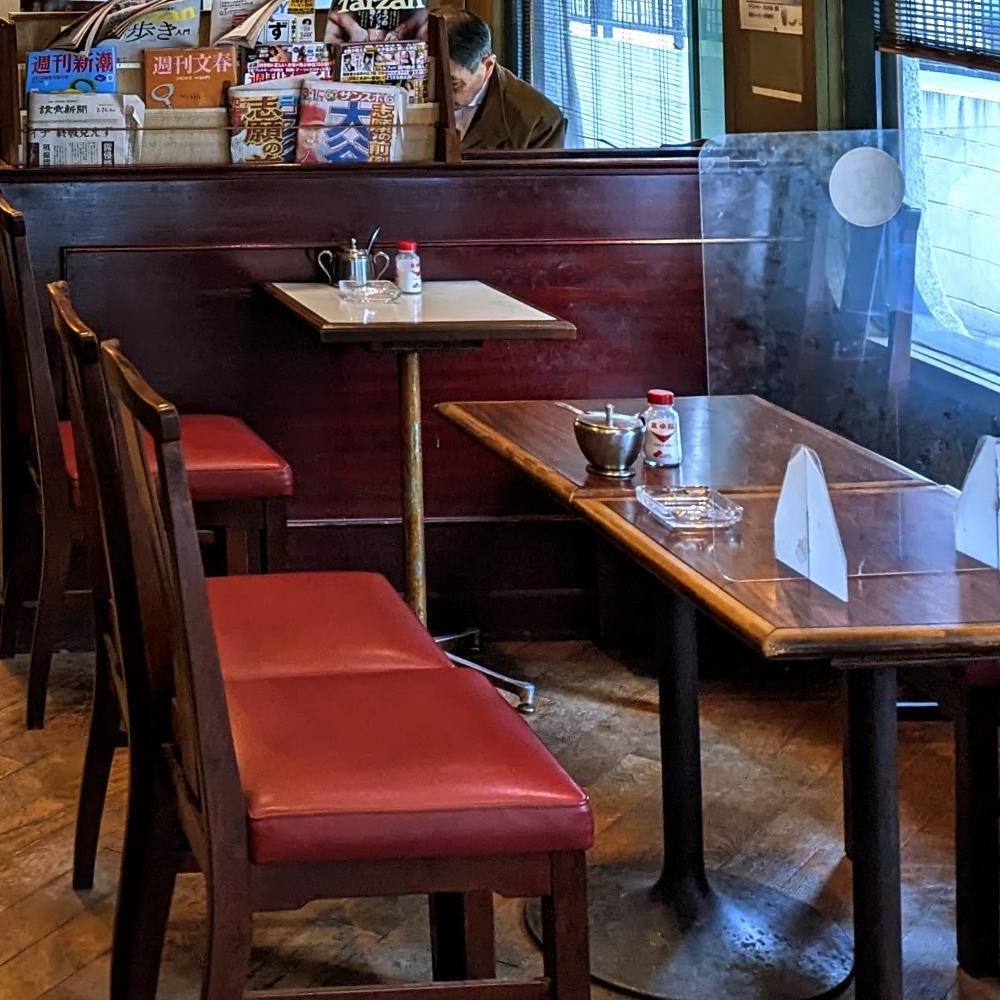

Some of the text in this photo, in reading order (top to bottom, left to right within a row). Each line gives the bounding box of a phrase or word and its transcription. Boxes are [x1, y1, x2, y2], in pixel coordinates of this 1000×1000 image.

[32, 52, 113, 74] 週刊新潮
[152, 53, 233, 75] 週刊文春
